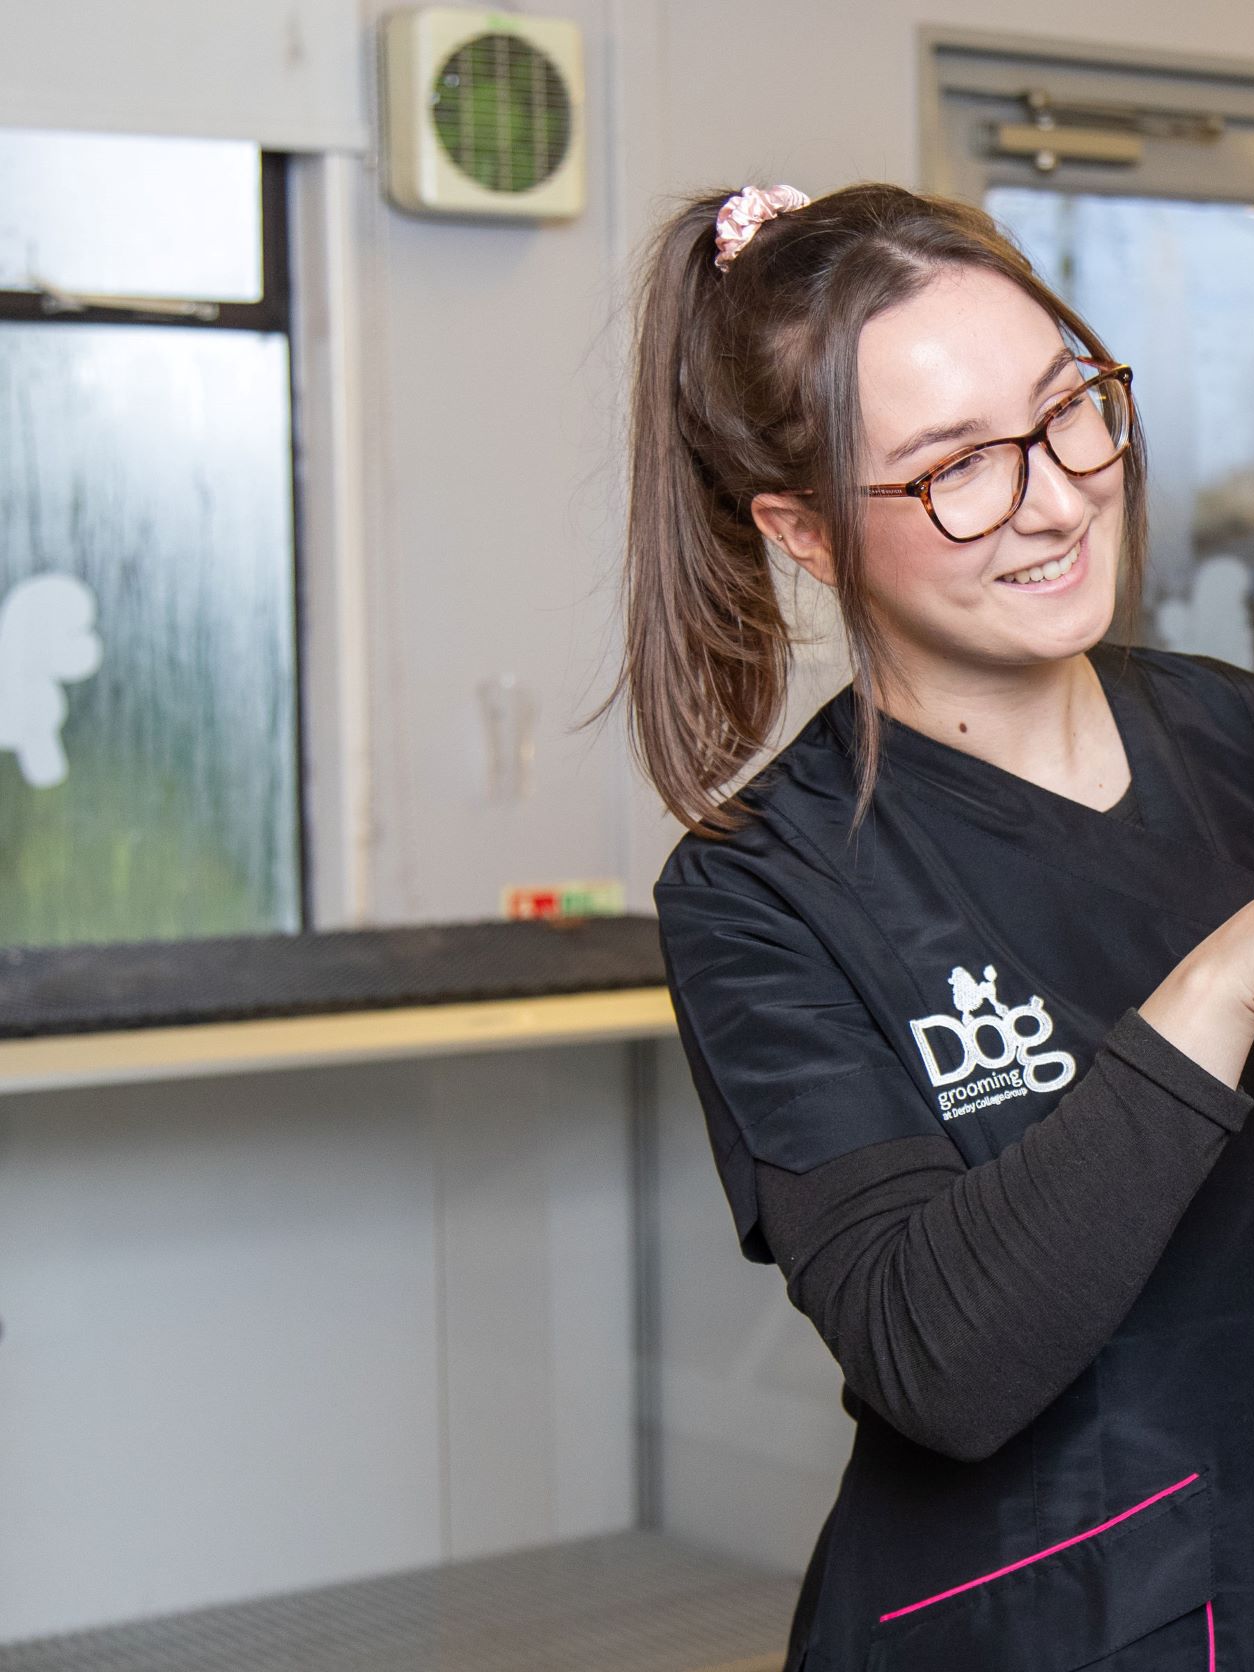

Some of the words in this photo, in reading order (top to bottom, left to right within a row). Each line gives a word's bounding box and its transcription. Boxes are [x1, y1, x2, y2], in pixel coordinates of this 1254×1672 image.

[909, 995, 1077, 1093] Dog
[938, 1069, 1023, 1111] grooming
[942, 1111, 953, 1121] at
[953, 1102, 976, 1118] Derby
[976, 1093, 1005, 1109] College
[1004, 1087, 1028, 1100] Group
